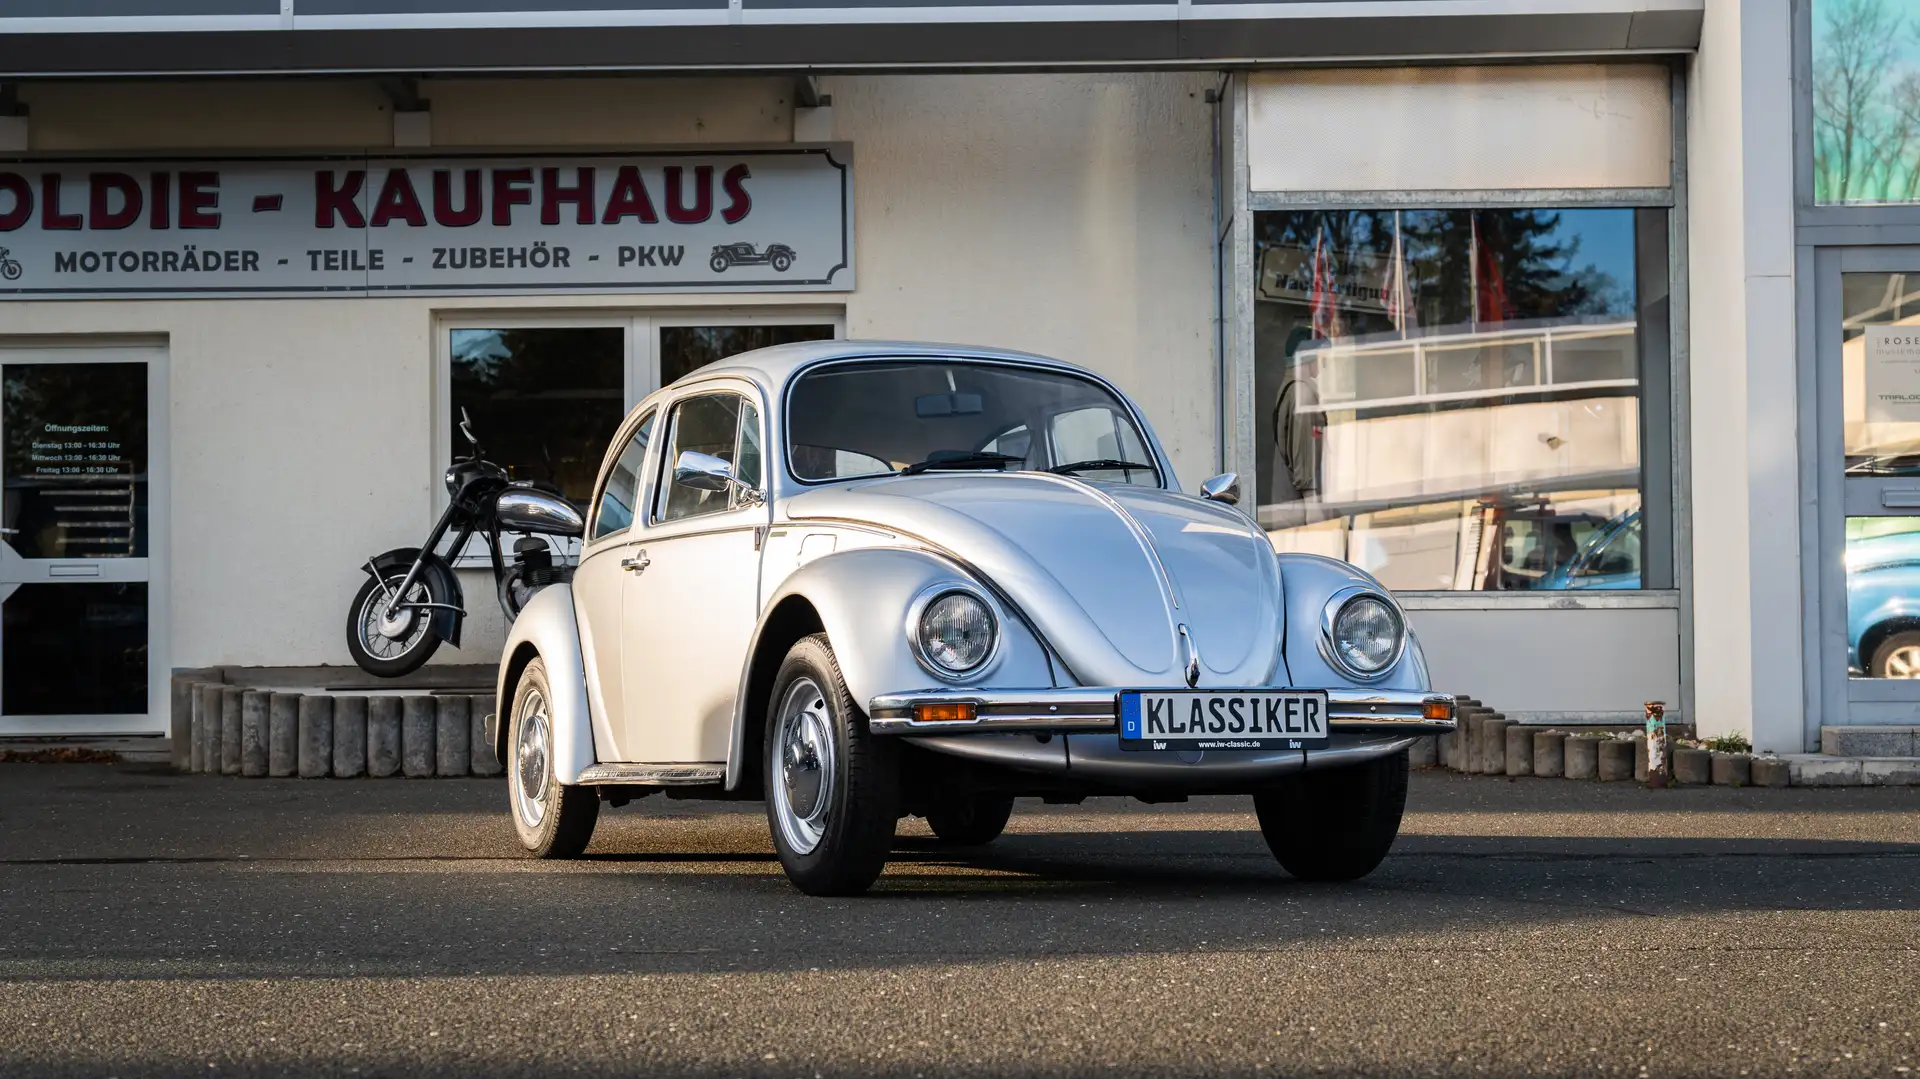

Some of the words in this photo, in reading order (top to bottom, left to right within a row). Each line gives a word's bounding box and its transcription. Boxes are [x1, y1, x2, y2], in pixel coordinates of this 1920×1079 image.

[0, 171, 222, 231] OLDIE
[252, 193, 283, 212] -
[314, 163, 752, 227] KAUFHAUS
[54, 244, 260, 273] MOTORRÄDER
[306, 249, 384, 272] TEILE
[432, 241, 571, 269] ZUBEHÖR
[588, 254, 600, 262] -
[618, 245, 685, 267] PKW
[45, 423, 108, 433] Öffnungszeiten:
[36, 466, 60, 475] Freitag
[1127, 721, 1135, 732] D
[1147, 698, 1320, 734] KLASSIKER
[1153, 740, 1167, 750] iw
[1198, 740, 1261, 749] www.iw-classic.de
[1289, 739, 1302, 749] iw
